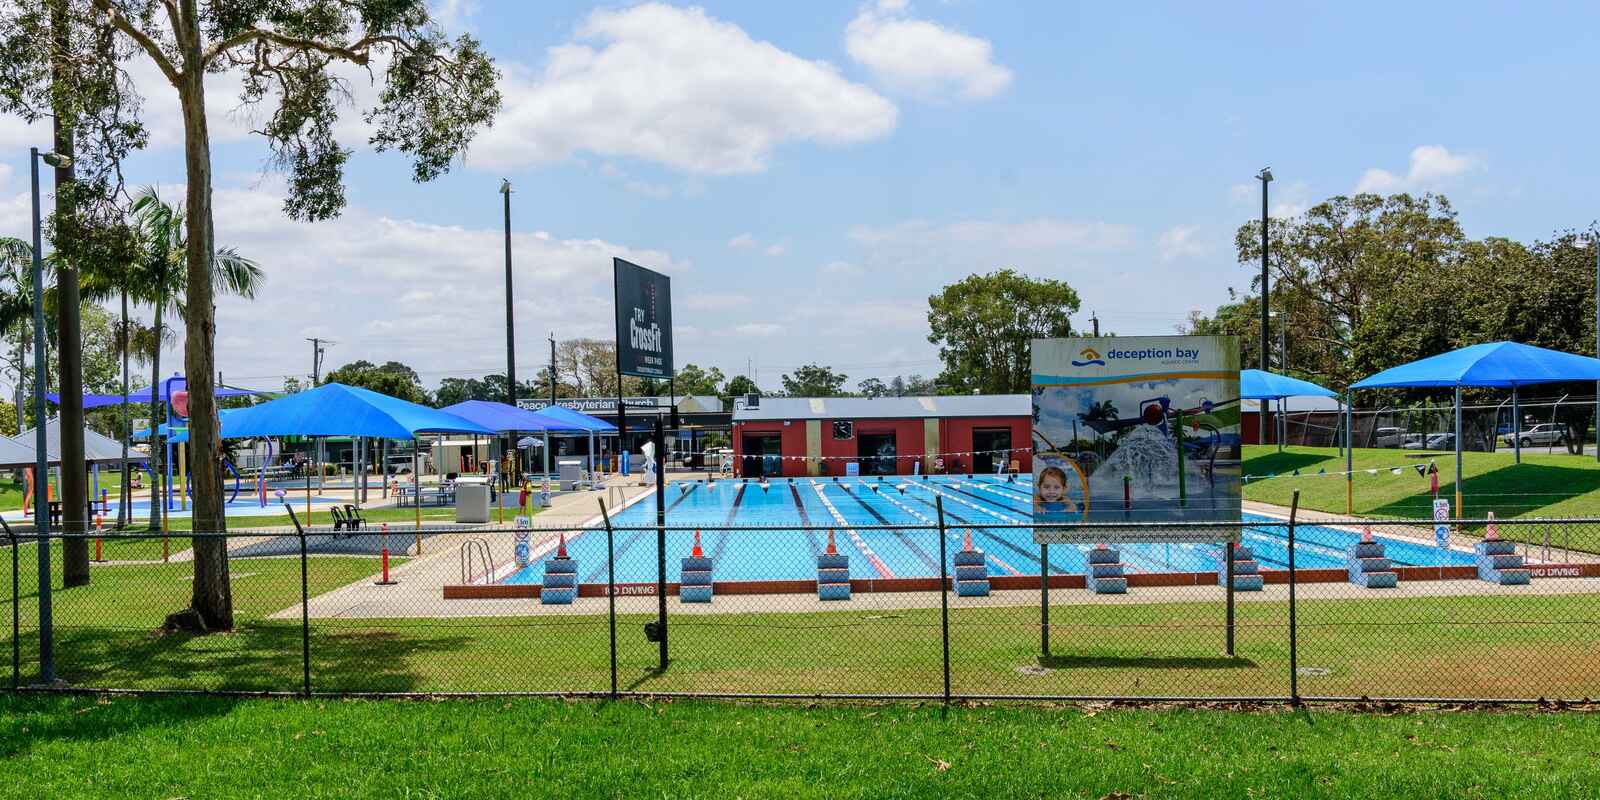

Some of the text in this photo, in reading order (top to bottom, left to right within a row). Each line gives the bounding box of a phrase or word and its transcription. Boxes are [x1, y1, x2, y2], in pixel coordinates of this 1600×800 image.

[634, 306, 645, 322] TRY
[630, 317, 662, 353] CrossFit
[1107, 347, 1200, 360] deception bay
[516, 400, 547, 410] Peace
[1531, 567, 1580, 576] NO DIVING
[621, 586, 655, 595] DIVING
